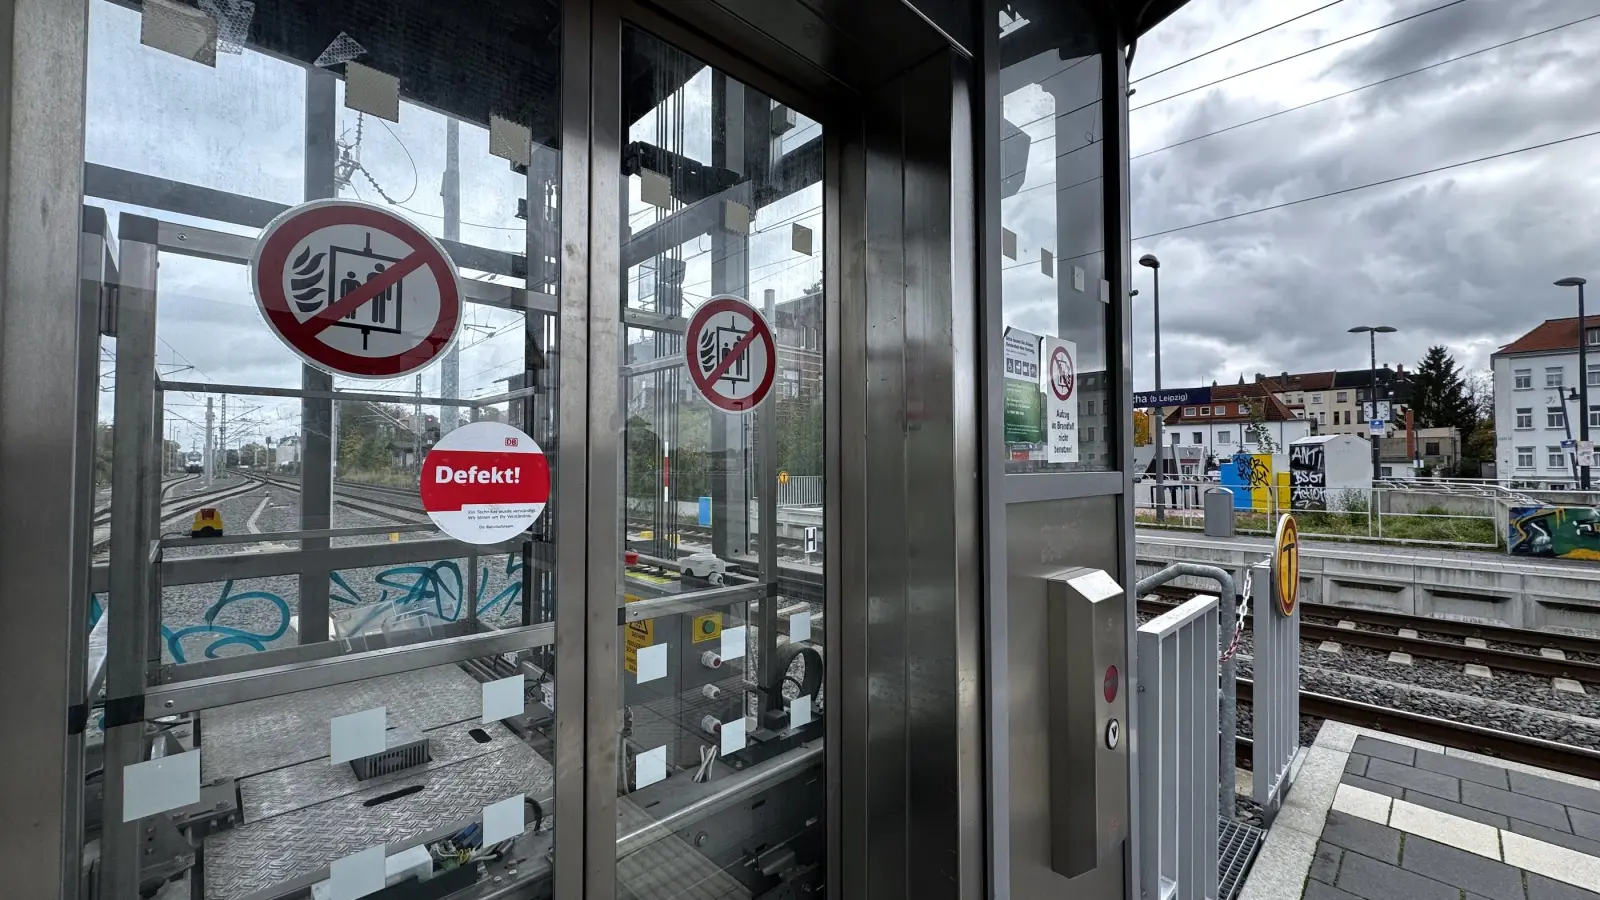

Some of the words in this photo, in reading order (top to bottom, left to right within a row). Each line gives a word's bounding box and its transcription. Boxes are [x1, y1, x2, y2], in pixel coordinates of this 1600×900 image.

[1150, 395, 1157, 403] (b
[1159, 392, 1188, 402] Leipzig)
[506, 438, 517, 446] DB
[435, 465, 521, 484] Defekt!
[806, 528, 815, 551] H
